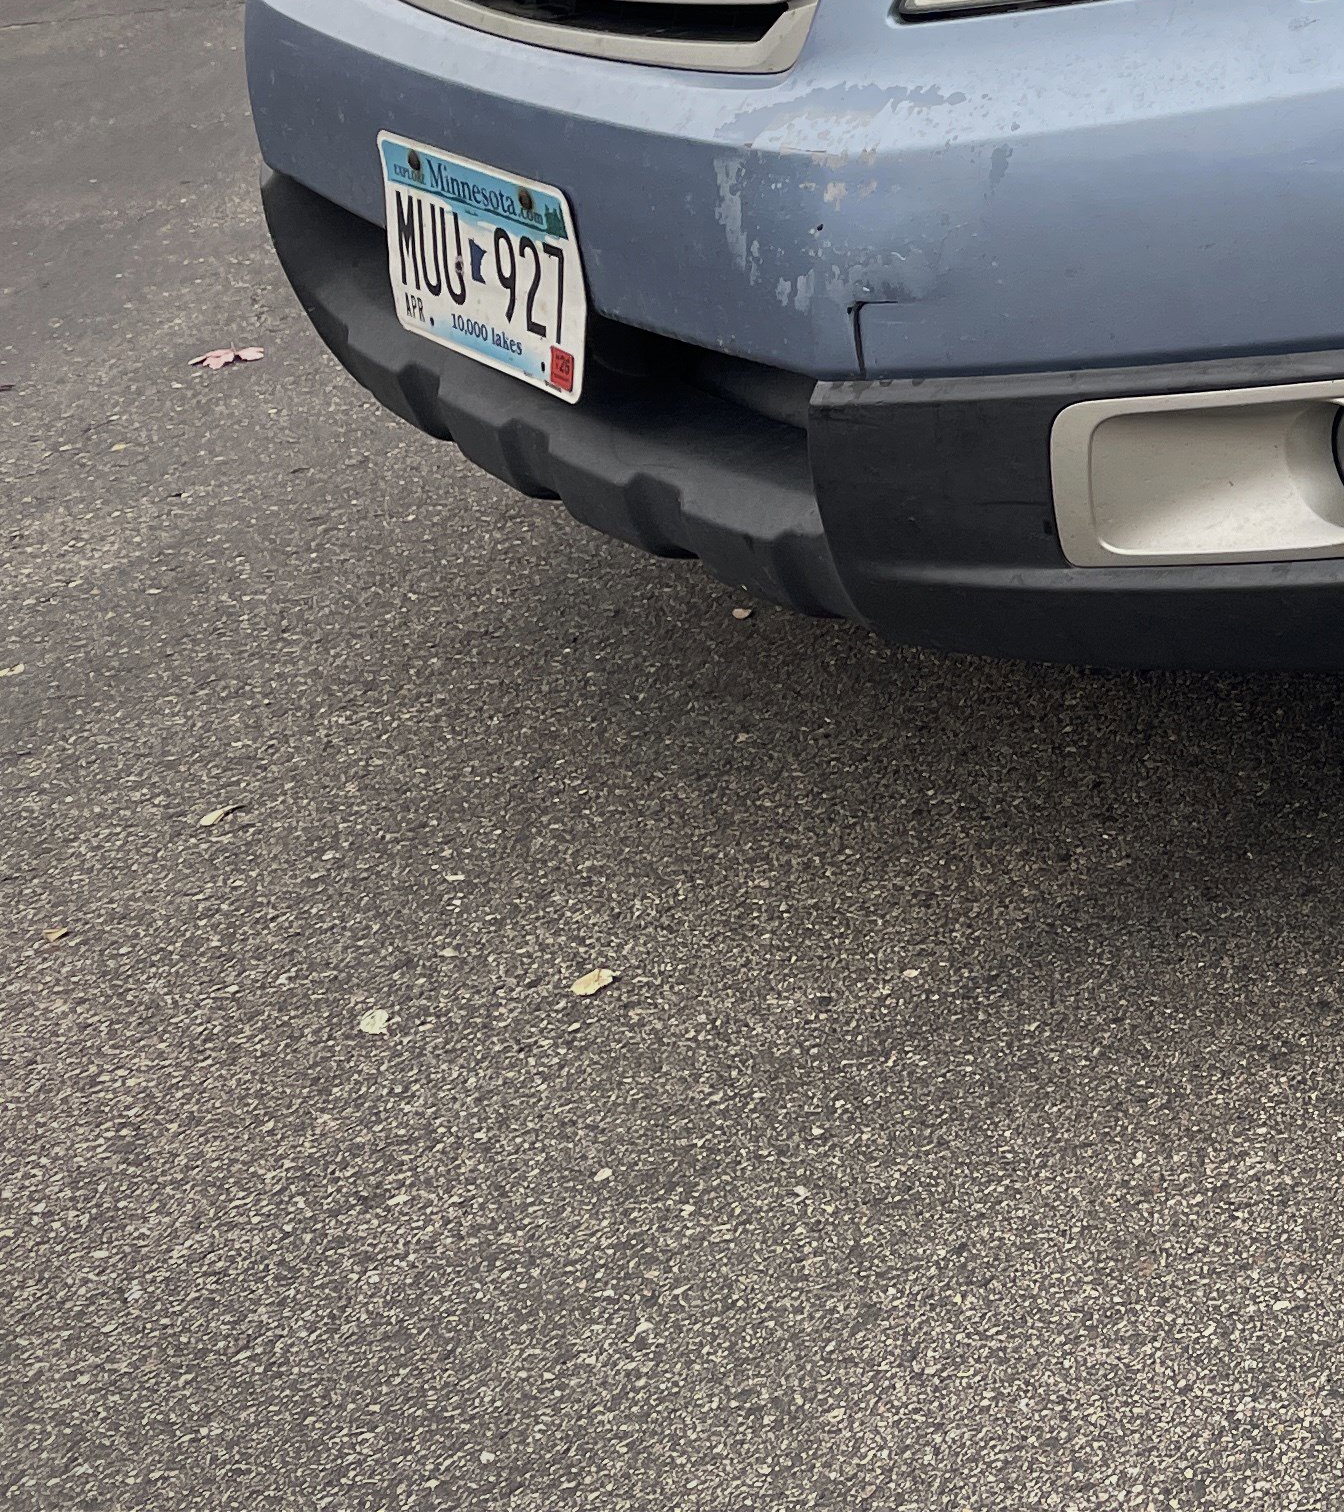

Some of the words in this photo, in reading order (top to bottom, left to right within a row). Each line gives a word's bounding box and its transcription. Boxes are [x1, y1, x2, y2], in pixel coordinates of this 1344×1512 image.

[404, 291, 426, 323] APR
[493, 227, 565, 345] 927
[450, 312, 488, 342] 10,000
[491, 326, 523, 356] lakes
